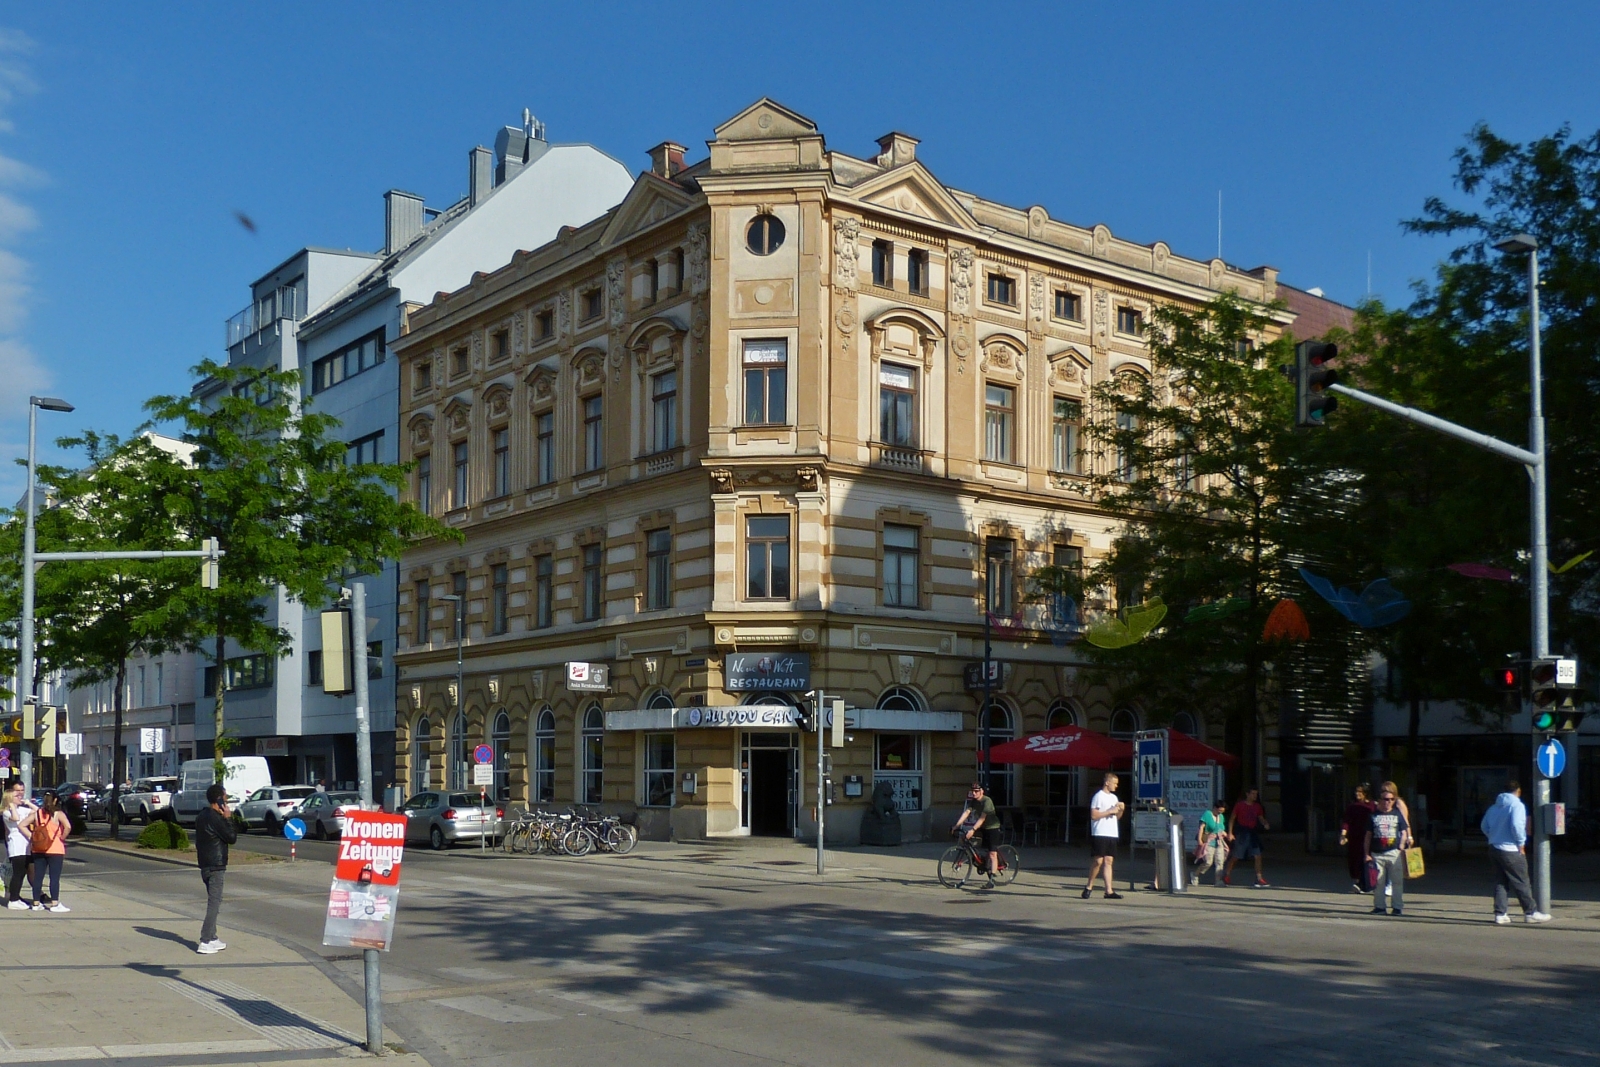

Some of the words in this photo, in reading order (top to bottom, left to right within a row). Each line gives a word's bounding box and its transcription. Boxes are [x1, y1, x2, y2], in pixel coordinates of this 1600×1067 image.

[1559, 667, 1573, 676] BUS
[729, 678, 806, 688] RESTAURANT
[705, 710, 725, 724] ALL
[729, 710, 758, 724] YOU
[762, 710, 793, 724] CAN
[1172, 780, 1209, 789] VOLKSFEST
[340, 817, 404, 839] Kronen
[340, 840, 403, 863] Zeitung
